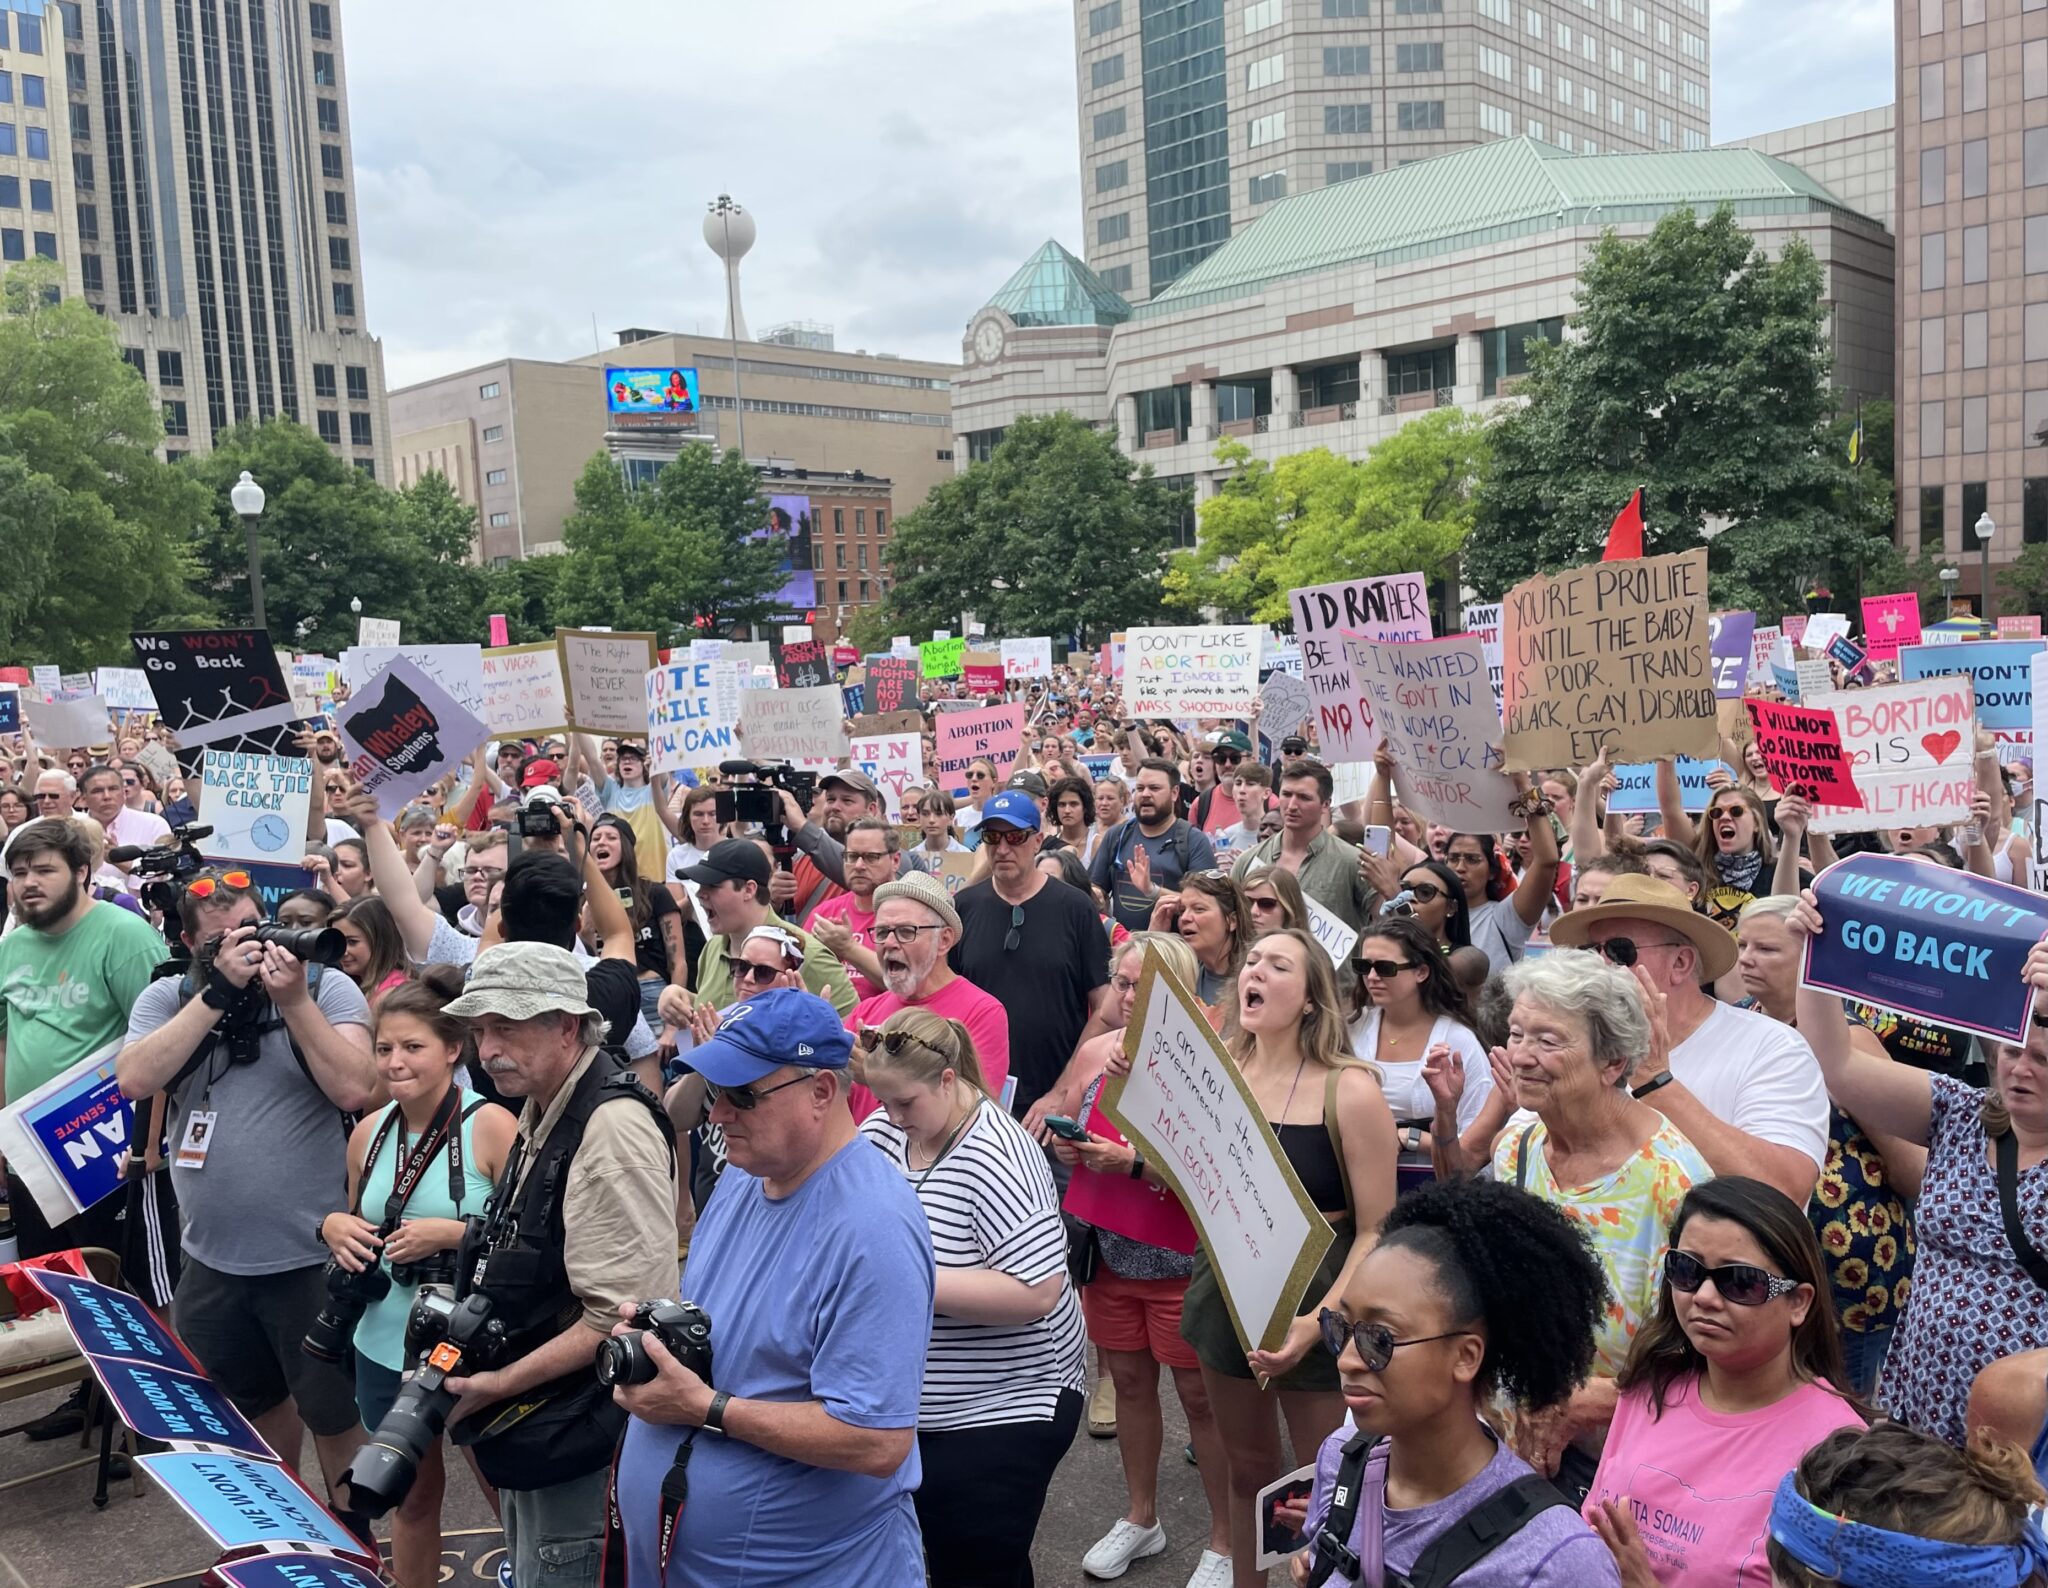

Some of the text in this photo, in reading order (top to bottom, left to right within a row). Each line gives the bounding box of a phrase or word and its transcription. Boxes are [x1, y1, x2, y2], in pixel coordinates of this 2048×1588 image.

[1298, 580, 1429, 633] I'D RATHER
[1468, 608, 1499, 626] AMY
[1513, 578, 1584, 632] YOU'RE
[135, 634, 255, 650] We WON'T
[779, 640, 824, 655] PEOPLE
[1200, 632, 1248, 648] LIKE
[1518, 604, 1695, 667] UNTIL THE BABY
[1753, 630, 1778, 642] FREE
[1754, 642, 1775, 652] FRE
[577, 642, 630, 664] The Right
[784, 648, 825, 664] AREN'T
[923, 642, 966, 656] Abortion
[1140, 652, 1252, 670] ABORTION?
[1305, 640, 1334, 670] BE
[1347, 641, 1478, 682] IF I WANTED
[1756, 652, 1770, 661] FR
[147, 654, 245, 671] Go Back
[502, 655, 538, 672] VIAGRA
[870, 668, 916, 681] RIGHTS
[879, 657, 908, 669] OUR
[926, 660, 956, 671] Human
[1267, 659, 1302, 671] VOTE
[1620, 645, 1704, 684] TRANS
[1757, 661, 1764, 671] F
[1957, 664, 2030, 681] WON'T
[449, 680, 472, 697] MY
[590, 675, 627, 690] NEVER
[647, 664, 710, 702] VOTE
[877, 679, 904, 690] ARE
[1170, 671, 1222, 683] IGNORE
[1225, 672, 1243, 681] IT
[1309, 671, 1350, 695] THAN
[876, 689, 904, 701] NOT
[1163, 688, 1177, 697] you
[1215, 686, 1224, 694] do
[1230, 685, 1249, 695] with
[1364, 679, 1471, 709] THE GOV'T IN
[515, 703, 544, 721] Dick
[648, 697, 710, 728] WHILE
[797, 699, 821, 713] are
[879, 700, 898, 712] UP
[1134, 700, 1251, 714] MASS SHOOTINGS
[1639, 688, 1717, 724] DISABLED
[1846, 688, 1973, 738] BORTION
[363, 703, 434, 758] Whaley
[812, 716, 831, 729] for
[948, 718, 1013, 739] ABORTION
[1379, 707, 1396, 732] MY
[1401, 713, 1467, 743] WOMB.
[1747, 703, 1762, 728] I
[1795, 717, 1832, 736] NOT
[386, 731, 434, 771] Stephens
[684, 726, 731, 752] CAN
[975, 739, 988, 751] IS
[1756, 732, 1842, 761] GO SILENTLY
[1875, 736, 1910, 764] IS
[265, 756, 313, 776] TURN
[1481, 741, 1500, 768] A
[1761, 754, 1791, 780] BACK
[204, 769, 261, 790] BACK
[1406, 768, 1482, 809] SENATOR
[226, 789, 285, 811] CLOCK
[1840, 873, 2037, 928] WE WON'T
[1842, 919, 1993, 981] GO BACK
[1912, 1027, 1939, 1042] FUCK
[1162, 994, 1254, 1162] I am not the
[54, 1103, 107, 1140] SENATE
[1152, 1031, 1274, 1232] governments playground
[367, 1132, 385, 1167] Canon
[397, 1128, 438, 1194] EOS 5D Mark IV
[451, 1136, 460, 1167] EOS R6
[1156, 1107, 1220, 1215] MY BODY!
[68, 1283, 133, 1352] WE WON'T
[106, 1297, 163, 1357] GO BACK
[128, 1367, 195, 1434] WE WON'T
[171, 1379, 230, 1437] GO BACK
[191, 1461, 280, 1531] WE WON'T
[229, 1458, 329, 1543] BACK DOWN
[1653, 1509, 1705, 1545] SOMANI
[661, 1514, 672, 1568] Canon
[1638, 1528, 1686, 1555] epresentative
